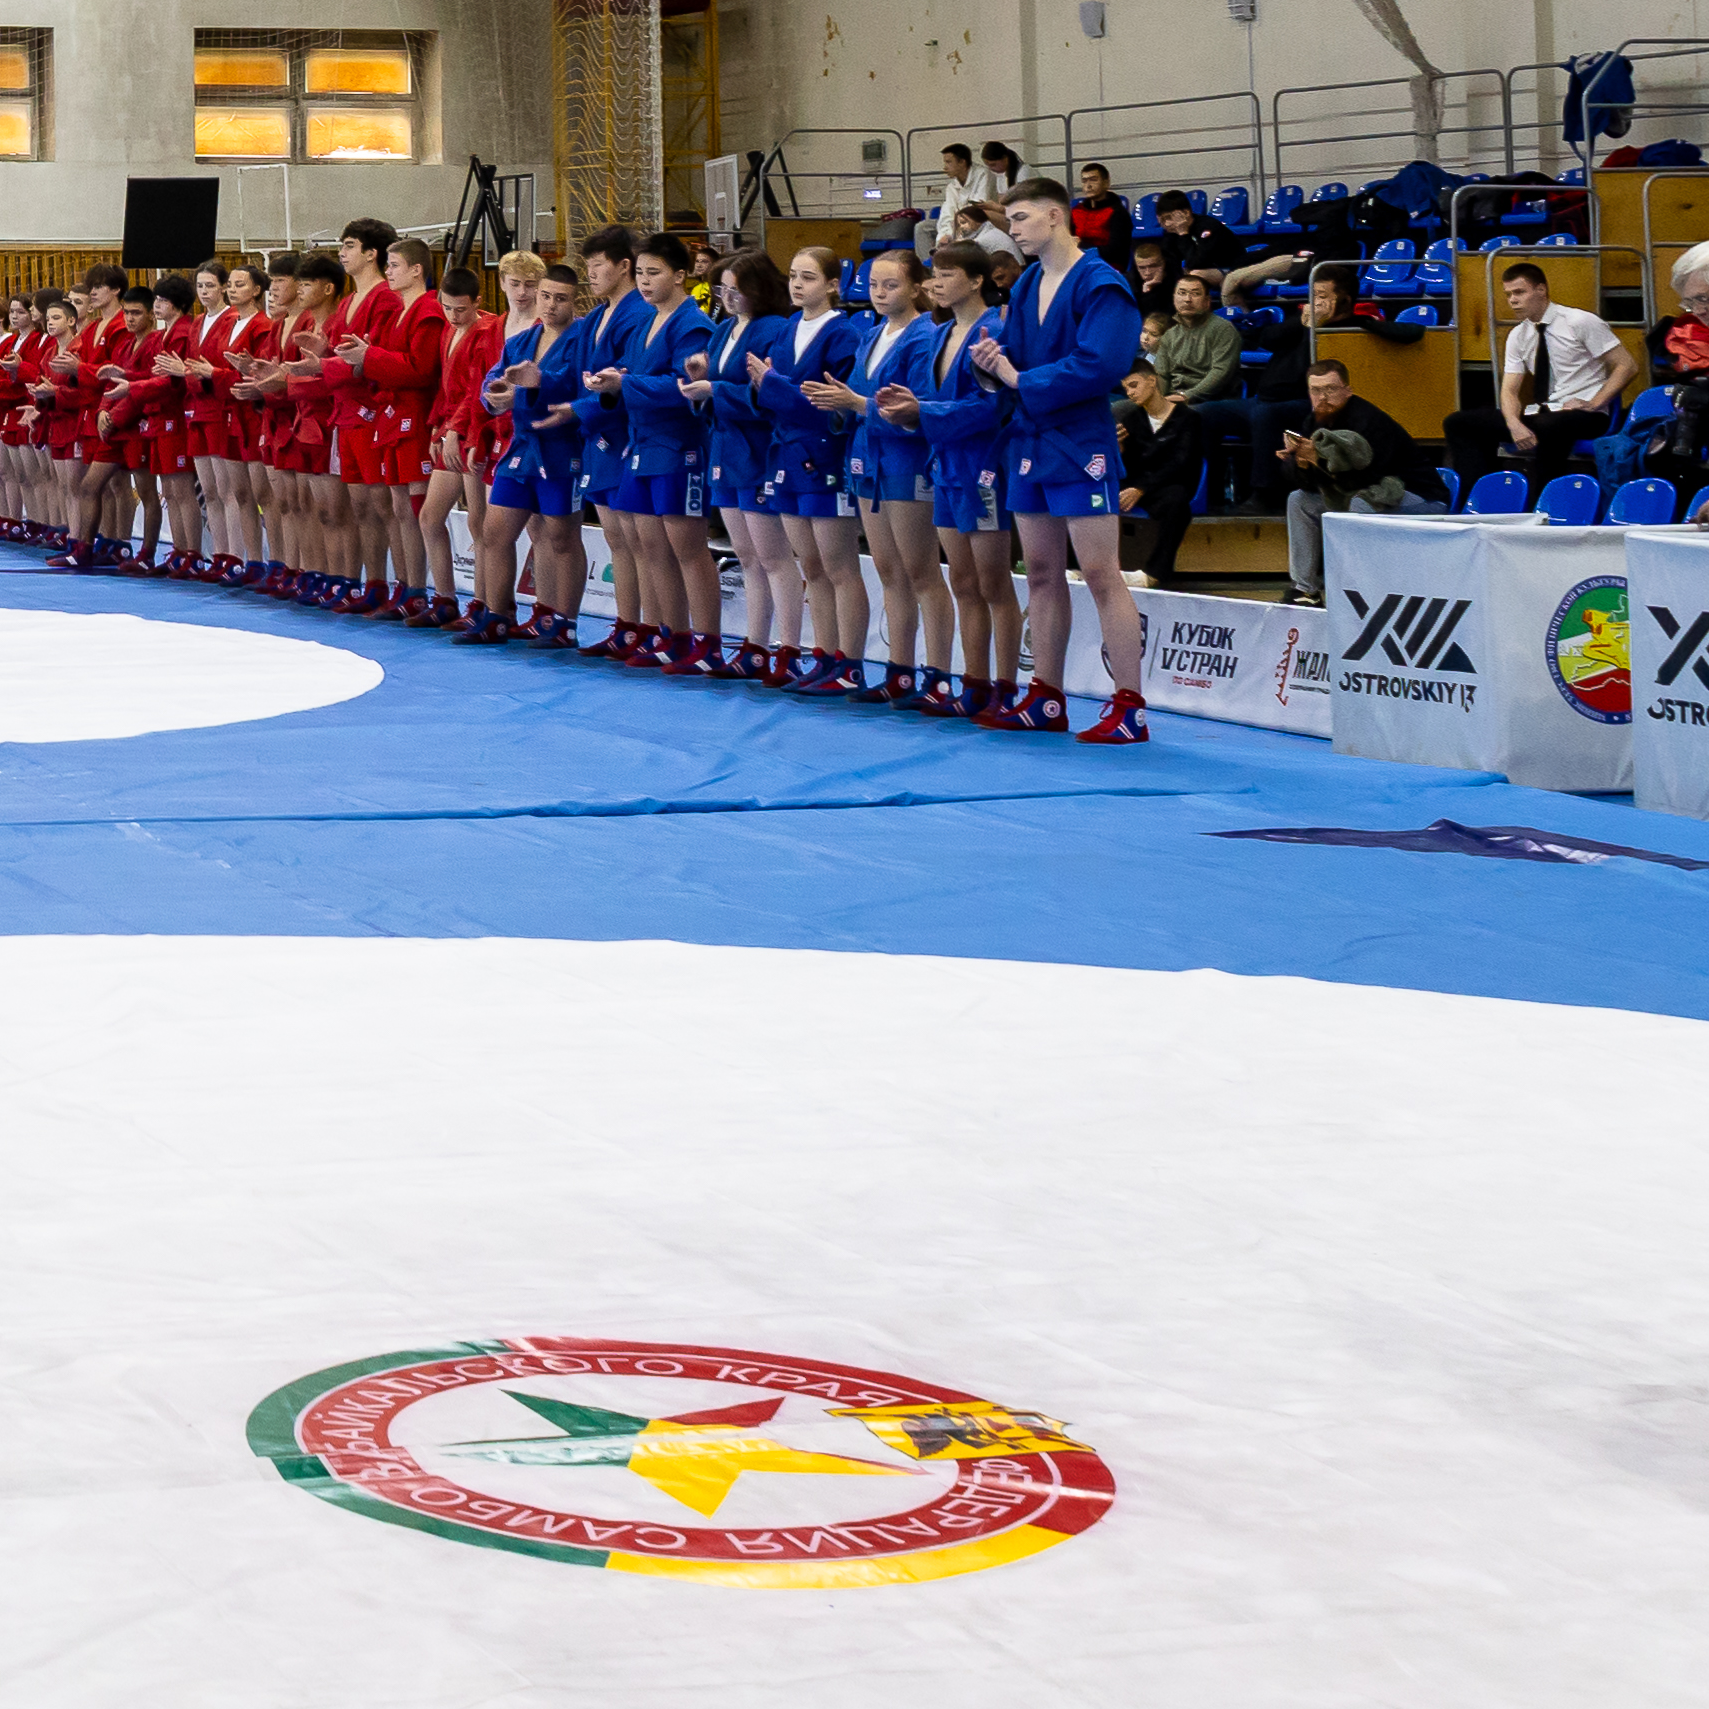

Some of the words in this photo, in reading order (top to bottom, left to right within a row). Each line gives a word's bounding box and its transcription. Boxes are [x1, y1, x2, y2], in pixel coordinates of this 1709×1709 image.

[1170, 621, 1237, 651] КУБОК
[411, 1488, 687, 1550] САМБО
[715, 1364, 903, 1407] КРАЯ
